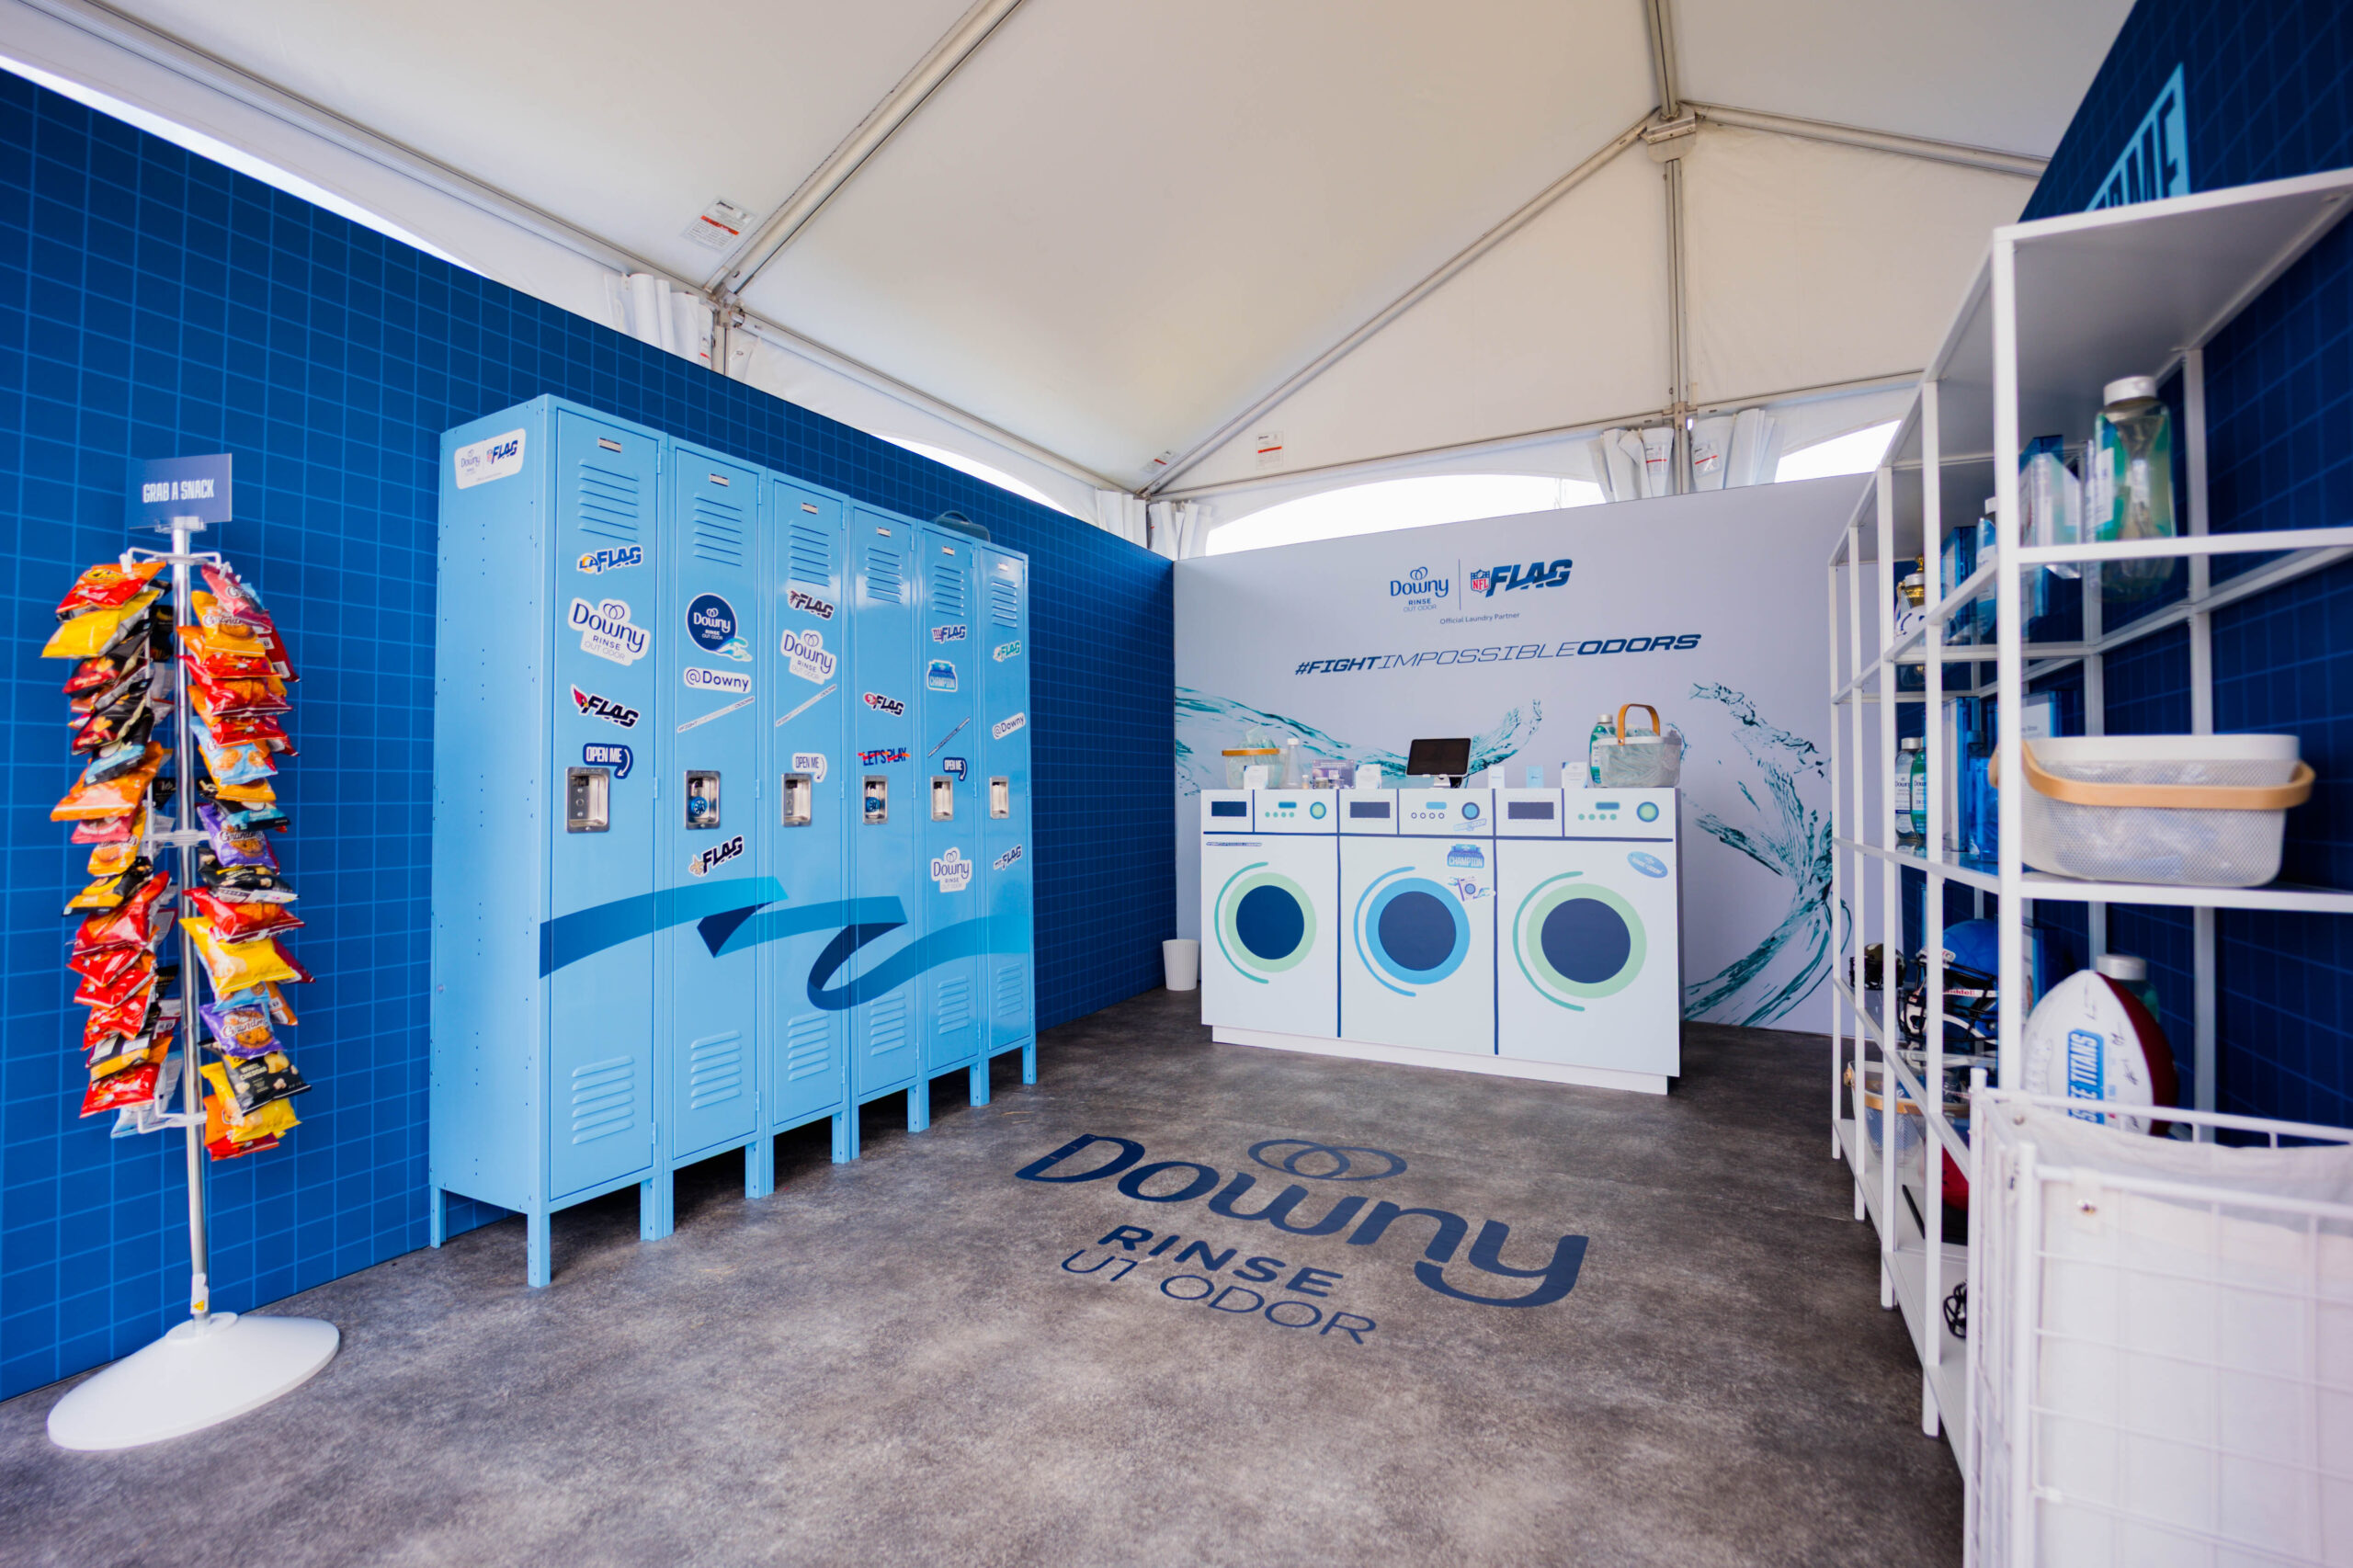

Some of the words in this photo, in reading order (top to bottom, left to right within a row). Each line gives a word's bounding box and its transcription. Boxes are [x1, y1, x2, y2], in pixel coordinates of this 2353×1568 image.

[491, 439, 518, 464] FLAG
[142, 483, 169, 503] GRAB
[171, 482, 178, 501] A
[181, 478, 214, 500] SNACK
[597, 546, 642, 572] FLAG
[1390, 578, 1449, 598] Downy
[1472, 578, 1489, 591] NFL
[1485, 559, 1573, 598] FLAG
[795, 594, 834, 619] FLAG
[573, 603, 644, 653] Downy
[693, 611, 732, 633] Downy
[1439, 616, 1464, 625] Official
[1465, 614, 1494, 623] Laundry
[1495, 612, 1520, 620] Partner
[592, 635, 621, 651] RINSE
[941, 625, 966, 642] FLAG
[584, 641, 601, 653] OUT
[602, 647, 626, 662] ODOR
[784, 634, 833, 675] Downy
[1000, 642, 1020, 656] FLAG
[1294, 633, 1701, 676] #FIGHTIMPOSSIBLEODORS
[797, 660, 817, 672] RINSE
[687, 668, 749, 692] @Downy
[581, 695, 639, 727] FLAG
[872, 695, 904, 716] FLAG
[993, 716, 1025, 738] @Downy
[585, 746, 608, 763] OPEN
[609, 747, 622, 763] ME
[795, 756, 810, 768] OPEN
[811, 756, 819, 768] ME
[862, 749, 887, 766] LET'S
[887, 747, 906, 763] PLAY
[701, 835, 743, 873] FLAG
[1002, 846, 1021, 869] FLAG
[1449, 856, 1483, 868] CHAMPION
[933, 861, 969, 880] Downy
[2070, 1031, 2098, 1086] TITANS
[1015, 1133, 1589, 1308] Downy
[1097, 1224, 1344, 1297] RINSE
[1160, 1275, 1377, 1345] ODOR
